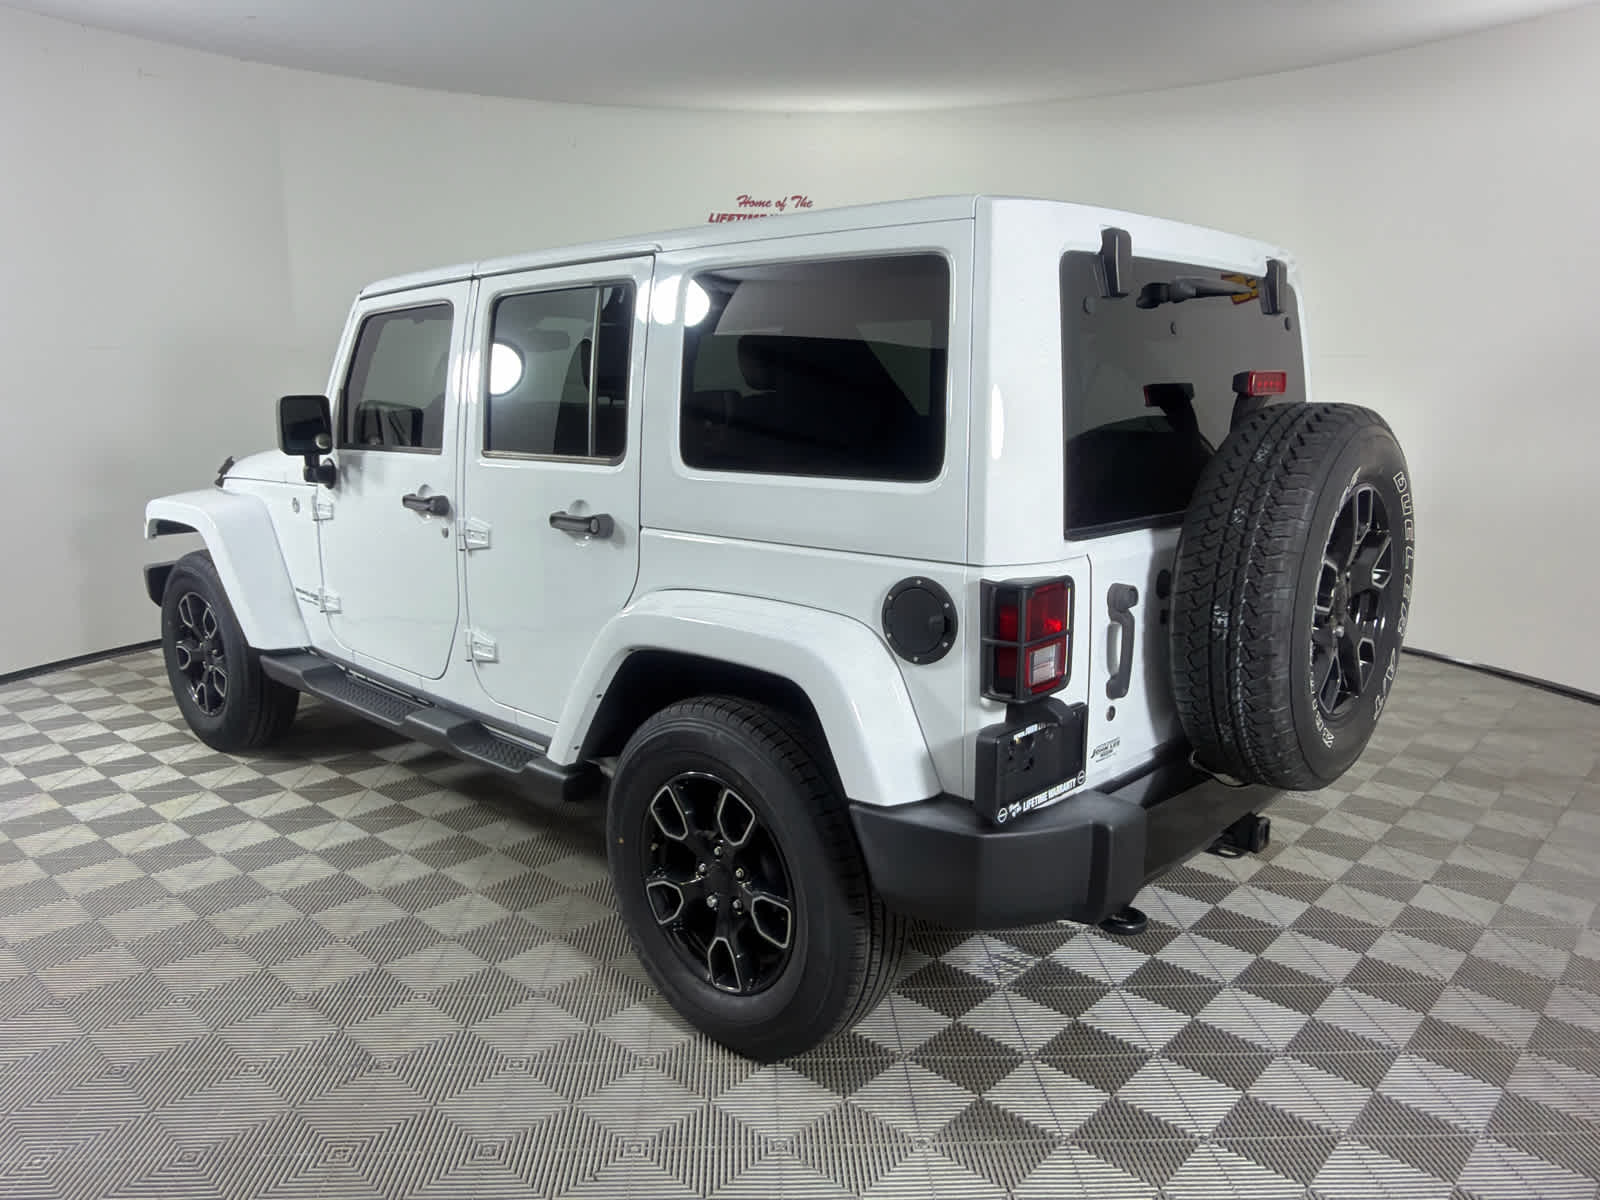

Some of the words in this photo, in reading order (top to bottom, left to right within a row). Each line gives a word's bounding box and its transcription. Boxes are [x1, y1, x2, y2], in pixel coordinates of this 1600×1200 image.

[736, 194, 773, 208] Home
[775, 196, 788, 211] of
[791, 194, 814, 208] The
[708, 212, 767, 223] LIFETIM
[1022, 791, 1048, 812] LIFETIME
